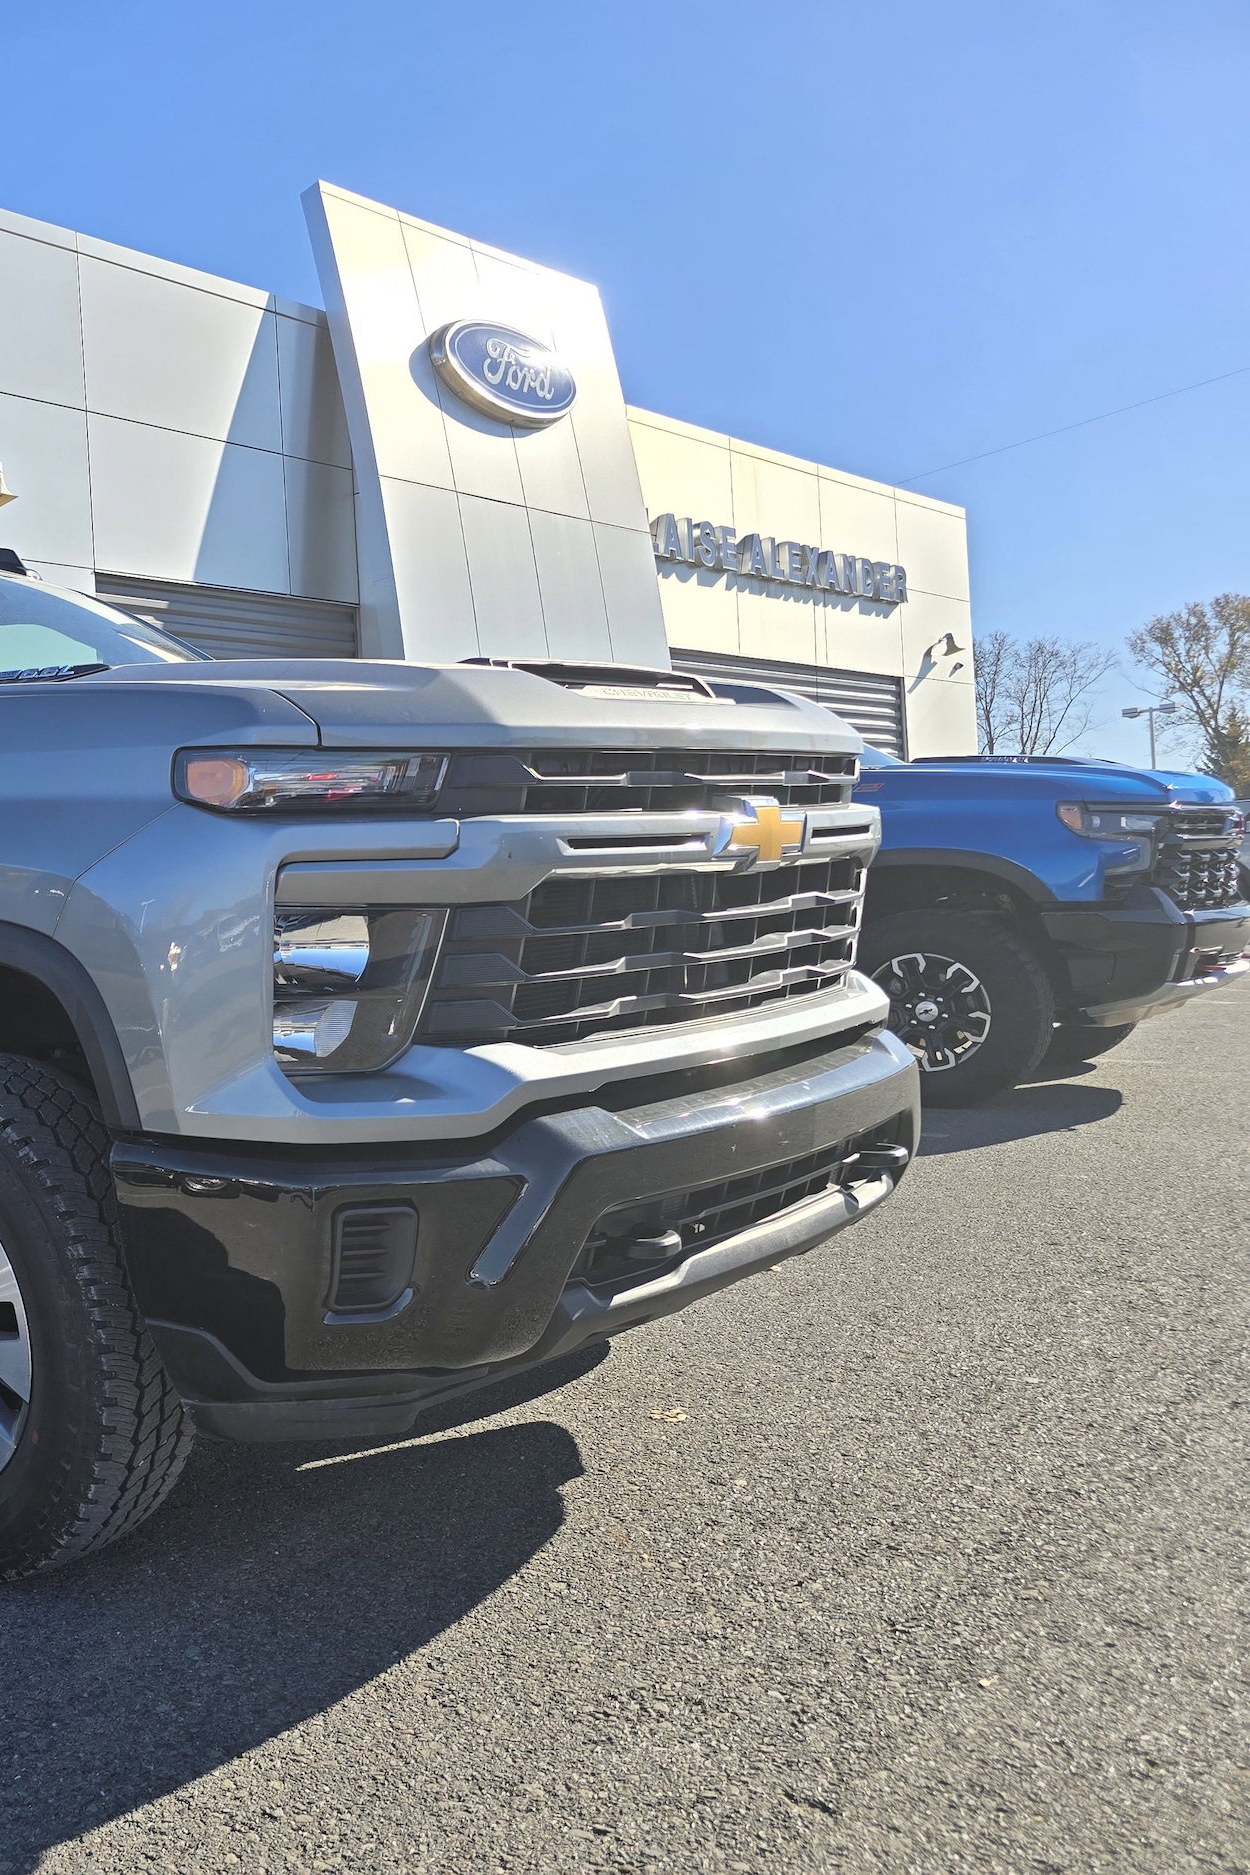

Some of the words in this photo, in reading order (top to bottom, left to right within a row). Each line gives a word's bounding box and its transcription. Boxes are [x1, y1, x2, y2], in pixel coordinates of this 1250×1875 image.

[483, 337, 555, 400] Ford
[651, 512, 739, 572] AISE
[742, 533, 909, 603] ALEXANDER
[602, 687, 692, 701] CHEVROLET
